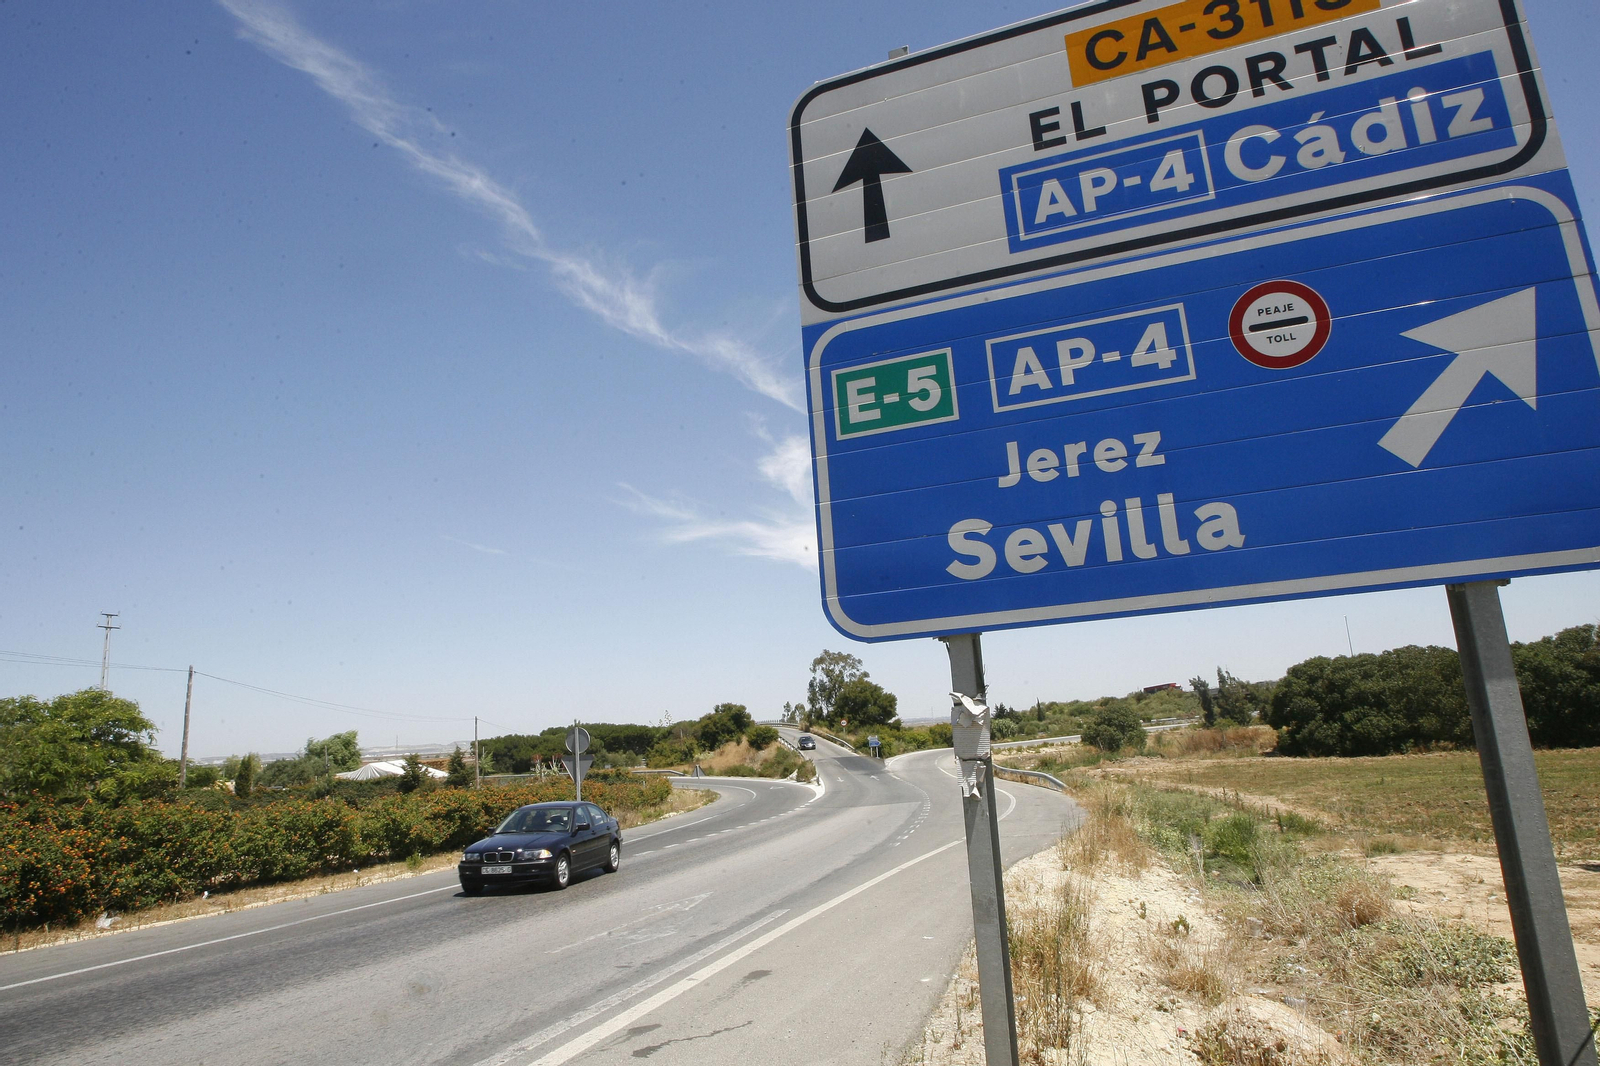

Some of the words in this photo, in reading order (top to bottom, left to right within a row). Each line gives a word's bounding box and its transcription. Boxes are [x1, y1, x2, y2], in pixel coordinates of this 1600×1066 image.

[1085, 0, 1352, 71] CA-31
[1029, 99, 1108, 152] EL
[1140, 16, 1443, 124] PORTAL
[1034, 149, 1195, 225] AP-4
[1224, 86, 1493, 183] Cádiz
[1257, 303, 1295, 317] PEAJE
[1266, 333, 1297, 344] TOLL
[846, 364, 942, 424] E-5
[1008, 320, 1177, 397] AP-4
[998, 430, 1166, 488] Jerez
[945, 492, 1246, 580] Sevilla
